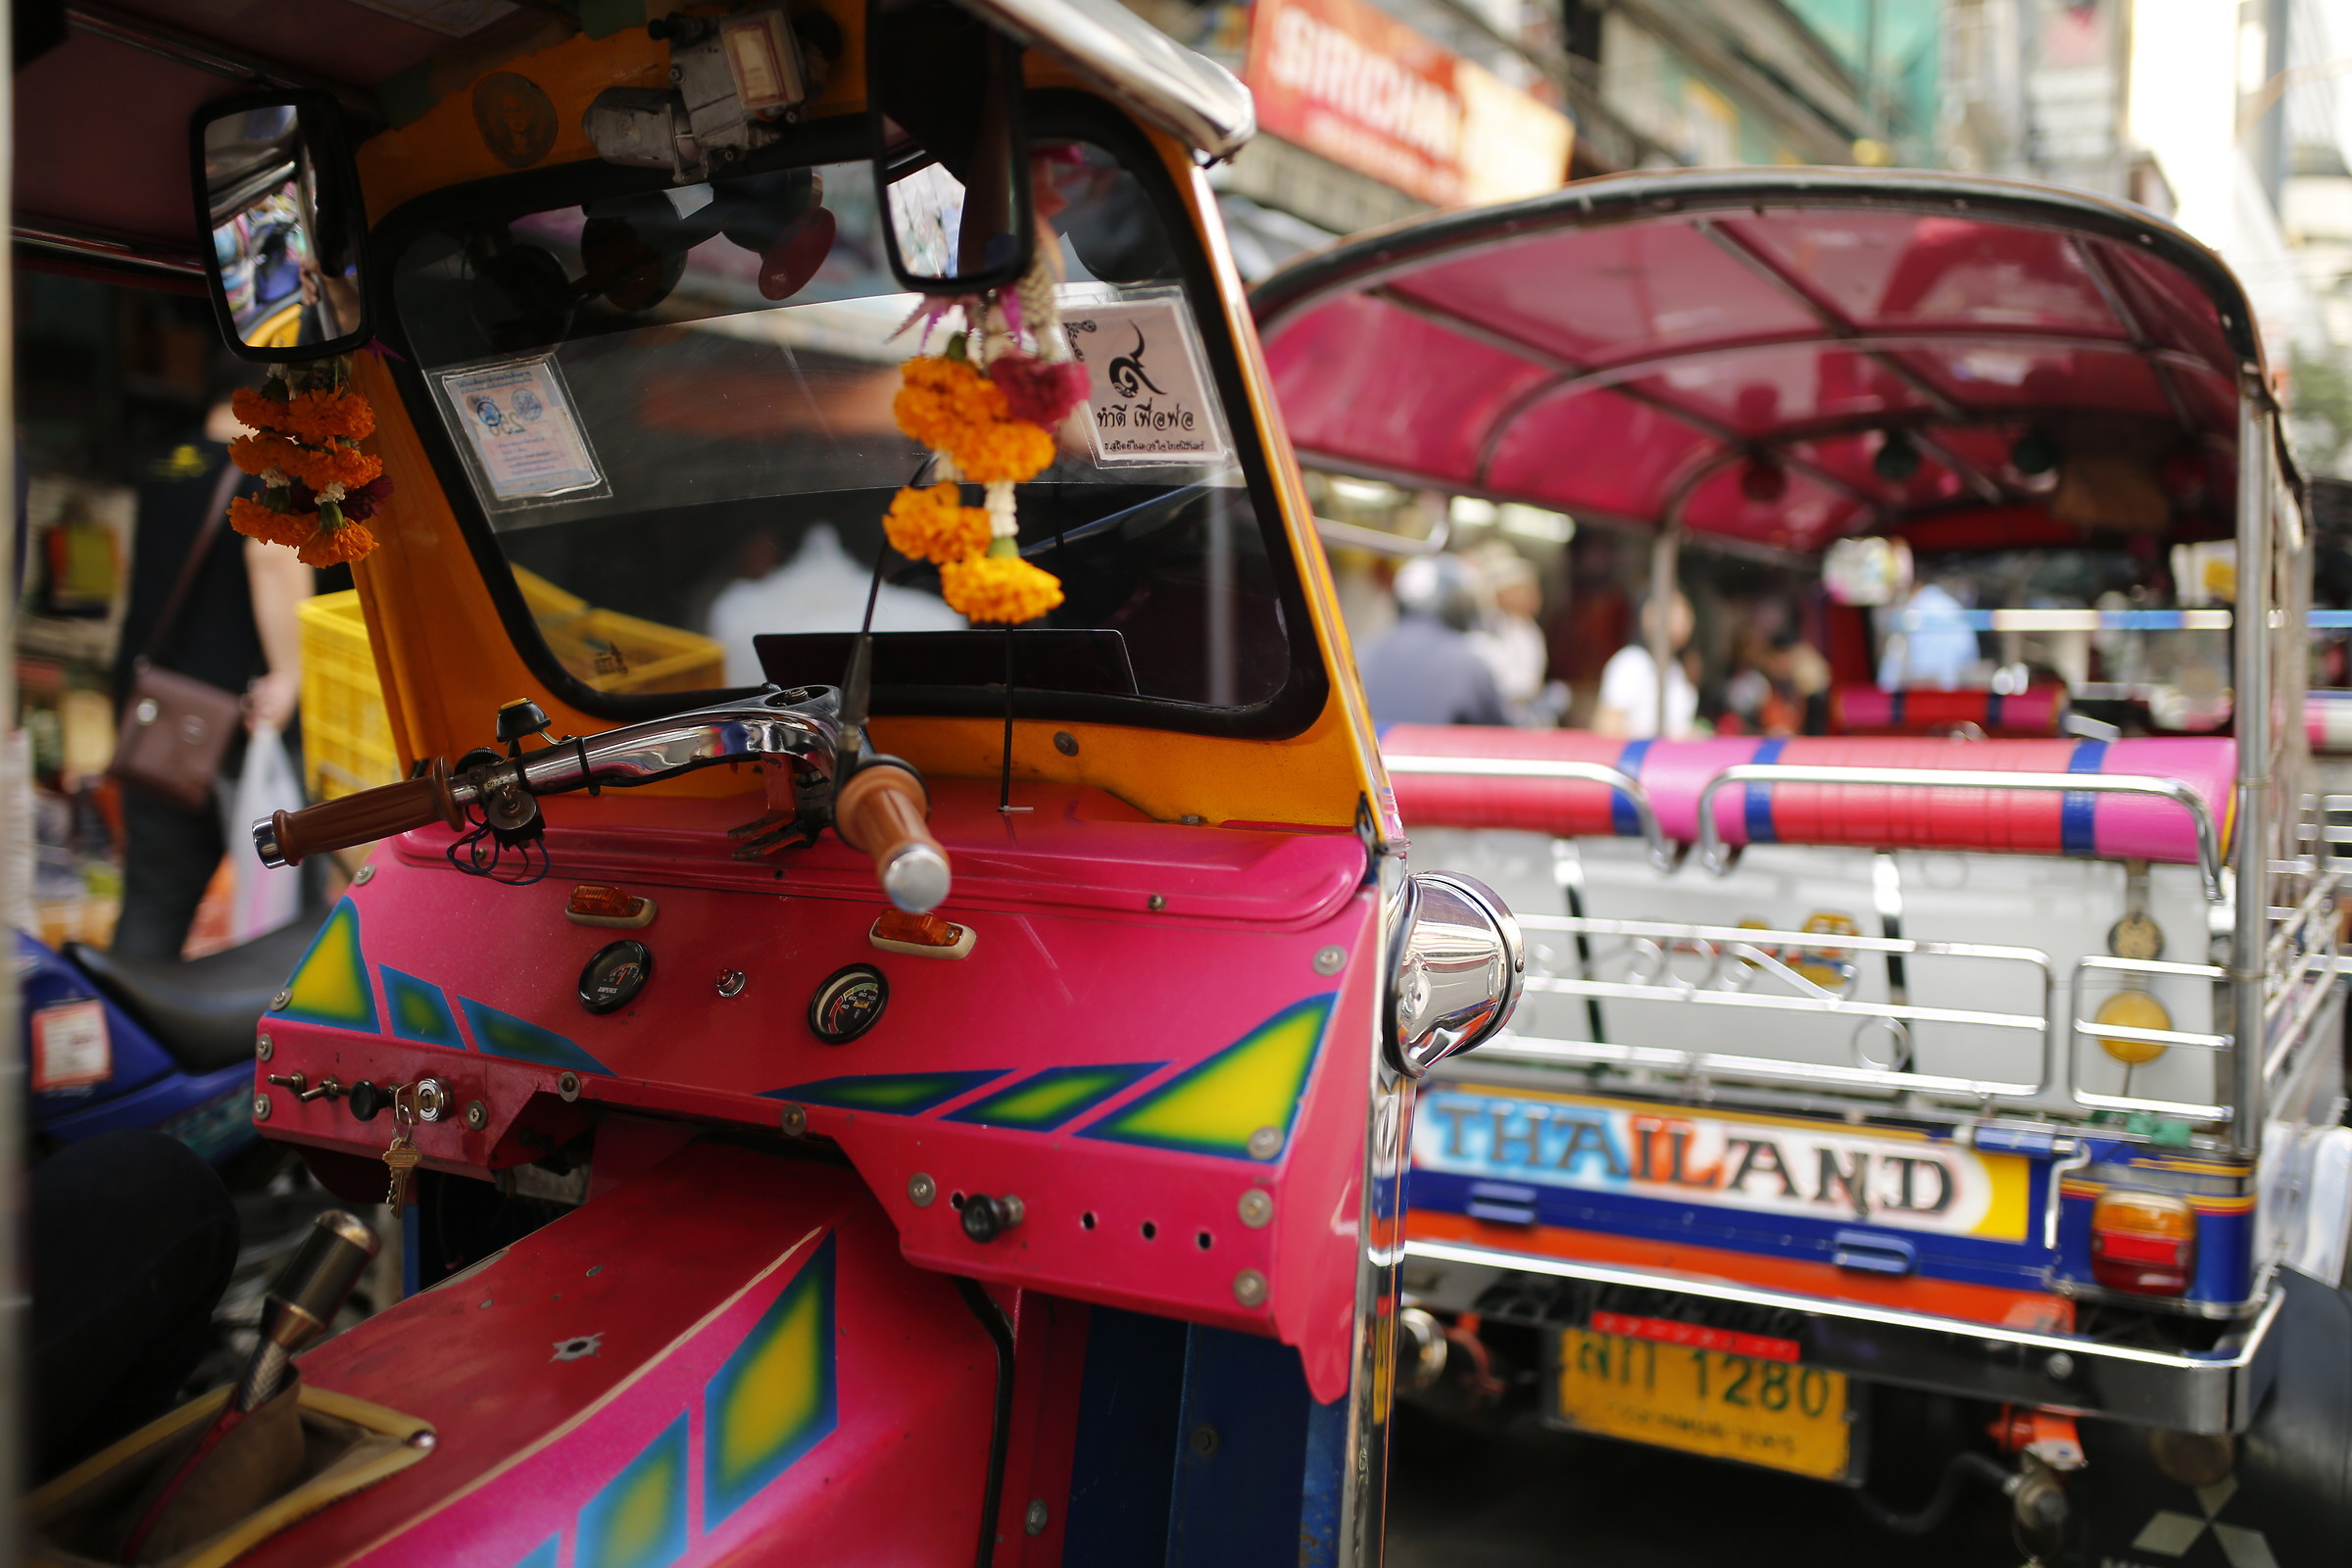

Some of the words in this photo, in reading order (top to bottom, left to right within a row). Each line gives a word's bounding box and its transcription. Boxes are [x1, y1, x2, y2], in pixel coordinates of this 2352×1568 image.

[1098, 403, 1127, 427] ทำดี
[1134, 397, 1196, 431] เพื่อพ่อ
[1434, 1102, 1954, 1215] THAILAND
[1692, 1348, 1830, 1419] 1280
